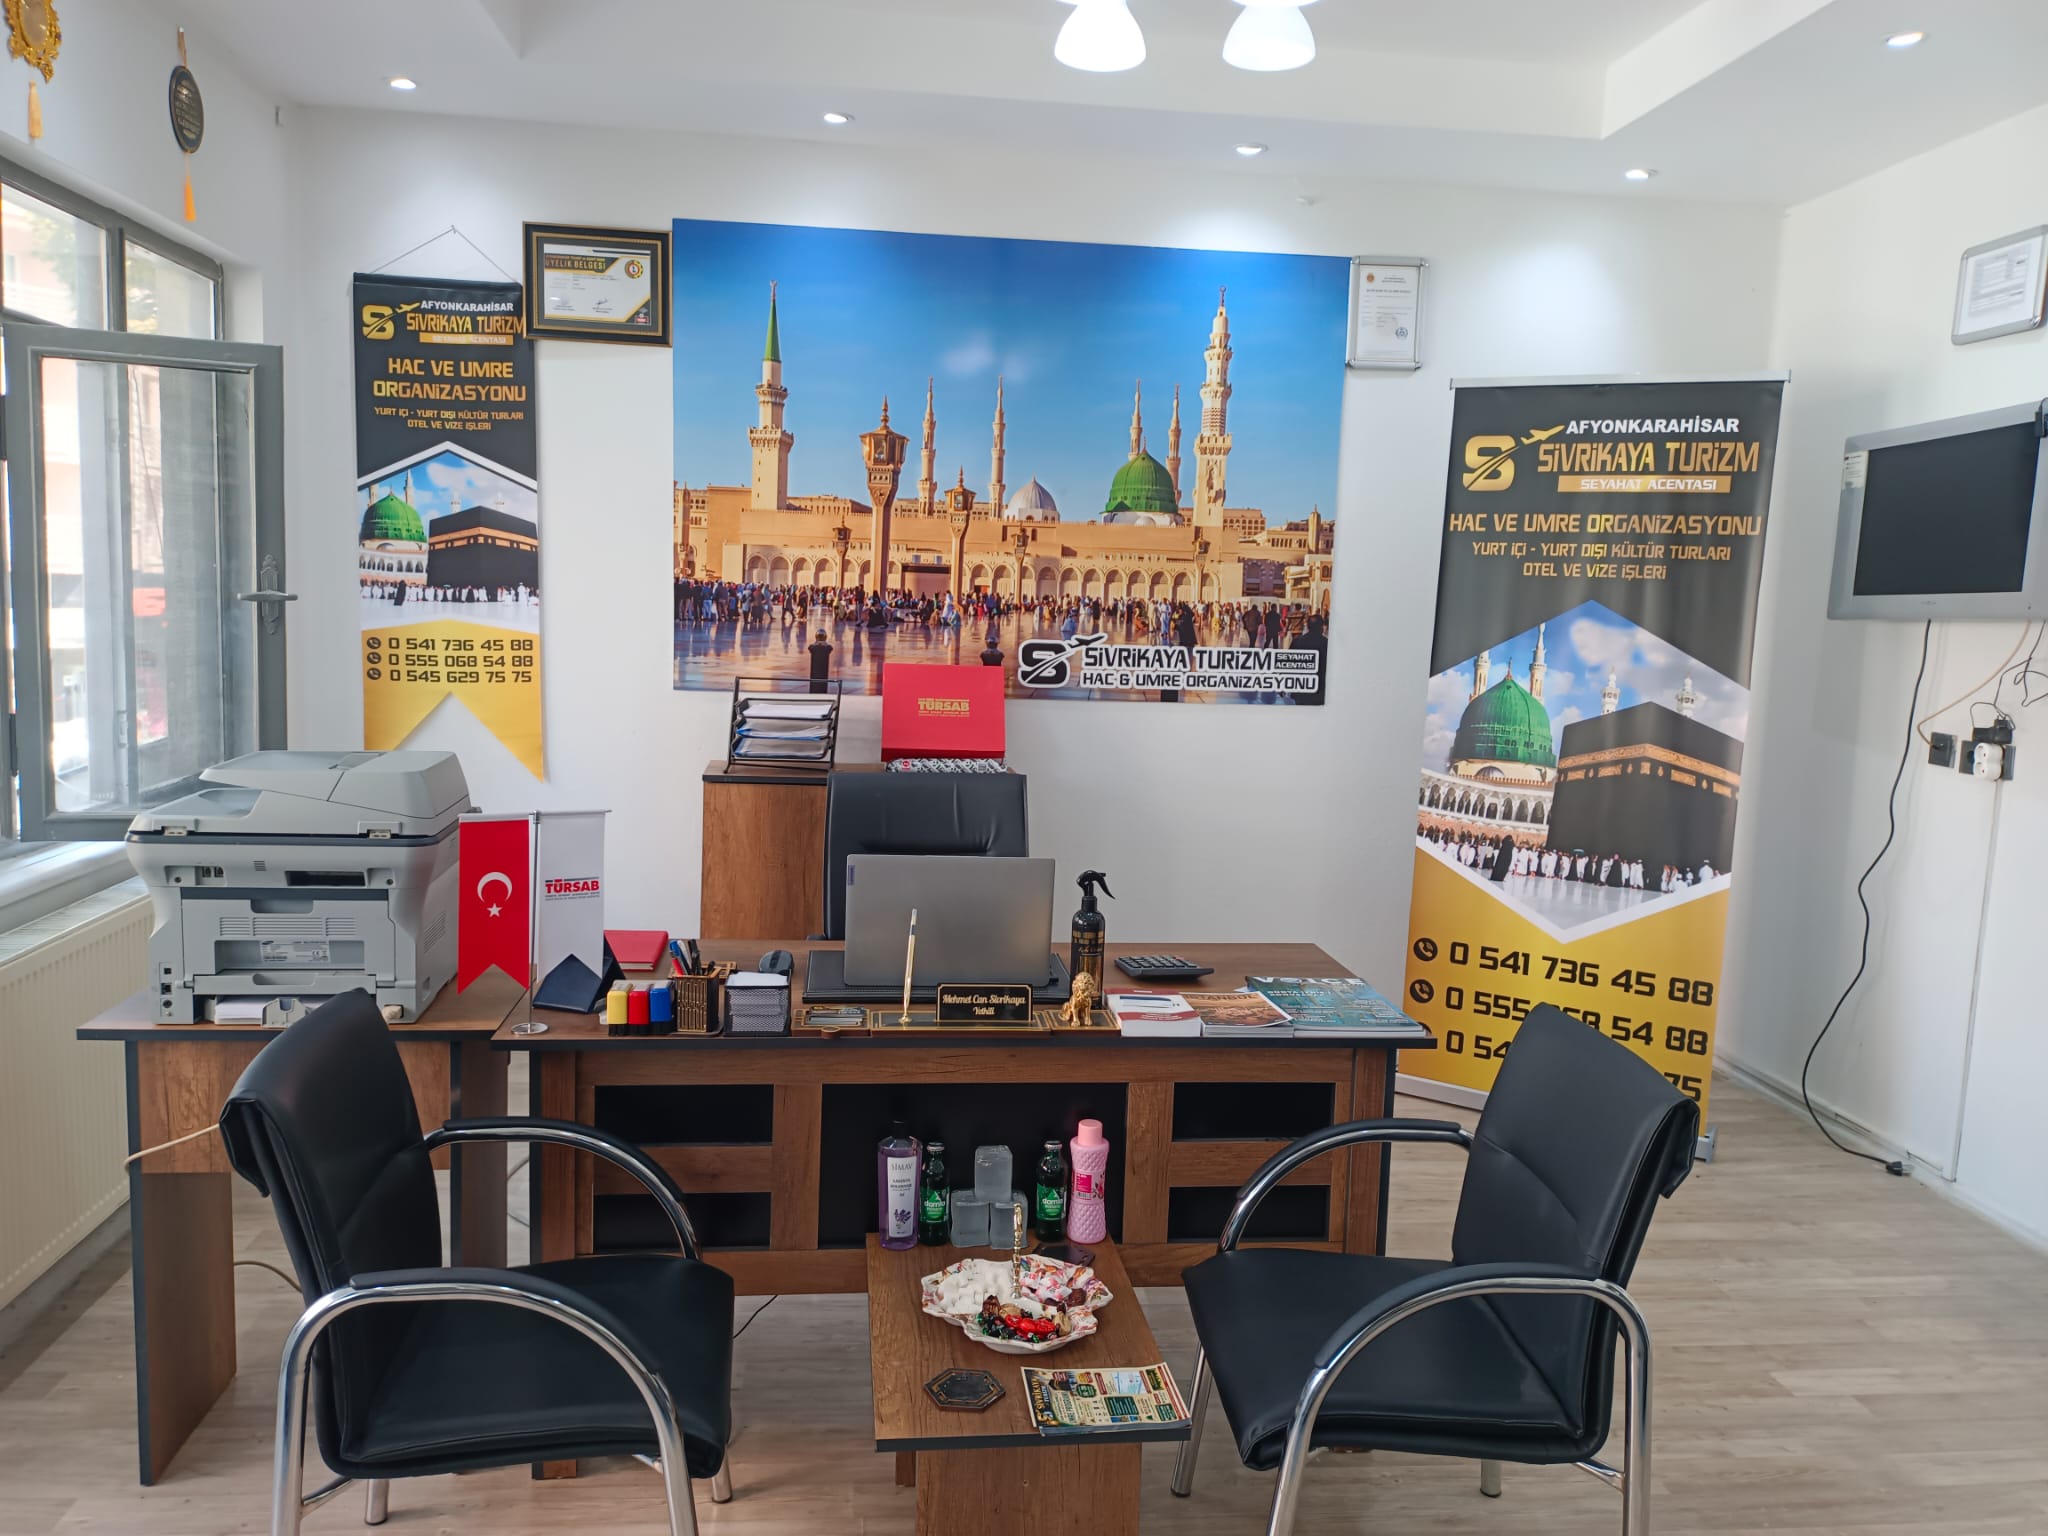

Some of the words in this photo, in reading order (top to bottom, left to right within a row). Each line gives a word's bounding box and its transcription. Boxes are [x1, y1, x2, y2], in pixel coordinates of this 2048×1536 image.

[420, 300, 514, 312] AFYONKARAHİSAR
[388, 358, 424, 376] HAC
[430, 360, 454, 376] VE
[460, 361, 514, 378] UMRE
[374, 407, 396, 416] YURT
[416, 409, 438, 418] YURT
[458, 409, 490, 420] KÜLTÜR
[492, 412, 524, 420] TURLARI
[408, 420, 429, 429] OTEL
[431, 421, 442, 430] VE
[1566, 415, 1740, 434] AFYONKARAHİSAR
[1580, 478, 1644, 491] SEYAHAT
[1647, 478, 1718, 491] ACENTASI
[1450, 514, 1486, 532] HAC
[1494, 514, 1518, 532] VE
[1524, 514, 1580, 534] UMRE
[1472, 542, 1508, 556] YURT
[1511, 542, 1526, 560] İÇİ
[1540, 543, 1578, 558] YURT
[1581, 543, 1608, 560] DIŞI
[1611, 541, 1664, 560] KÜLTÜR
[1670, 546, 1731, 561] TURLARI
[1523, 562, 1558, 578] OTEL
[1563, 563, 1581, 578] VE
[1586, 564, 1617, 578] VİZE
[388, 637, 400, 650] 0
[406, 638, 436, 650] 541
[442, 639, 474, 651] 736
[480, 640, 504, 651] 45
[510, 640, 533, 651] 88
[388, 654, 400, 666] 0
[406, 654, 438, 667] 555
[444, 656, 478, 668] 068
[483, 656, 506, 668] 54
[512, 656, 533, 668] 88
[1277, 653, 1314, 661] SEYAHAT
[1276, 661, 1316, 670] ACENTASI
[390, 670, 400, 682] 0
[406, 670, 440, 682] 545
[446, 671, 480, 683] 629
[486, 672, 506, 683] 75
[512, 672, 532, 682] 75
[1083, 673, 1114, 686] HAC
[1136, 674, 1181, 686] UMRE
[918, 698, 970, 712] TÜRSAB
[545, 879, 600, 894] TÜRSAB
[1450, 941, 1469, 966] 0
[1480, 945, 1530, 976] 541
[1542, 956, 1600, 987] 736
[1611, 969, 1656, 997] 45
[1668, 976, 1714, 1007] 88
[973, 994, 988, 1004] Can
[1446, 986, 1464, 1010] 0
[1473, 991, 1530, 1022] 555
[1612, 1015, 1654, 1046] 54
[1665, 1025, 1708, 1056] 88
[1446, 1030, 1464, 1054] 0
[1473, 1035, 1512, 1060] 54
